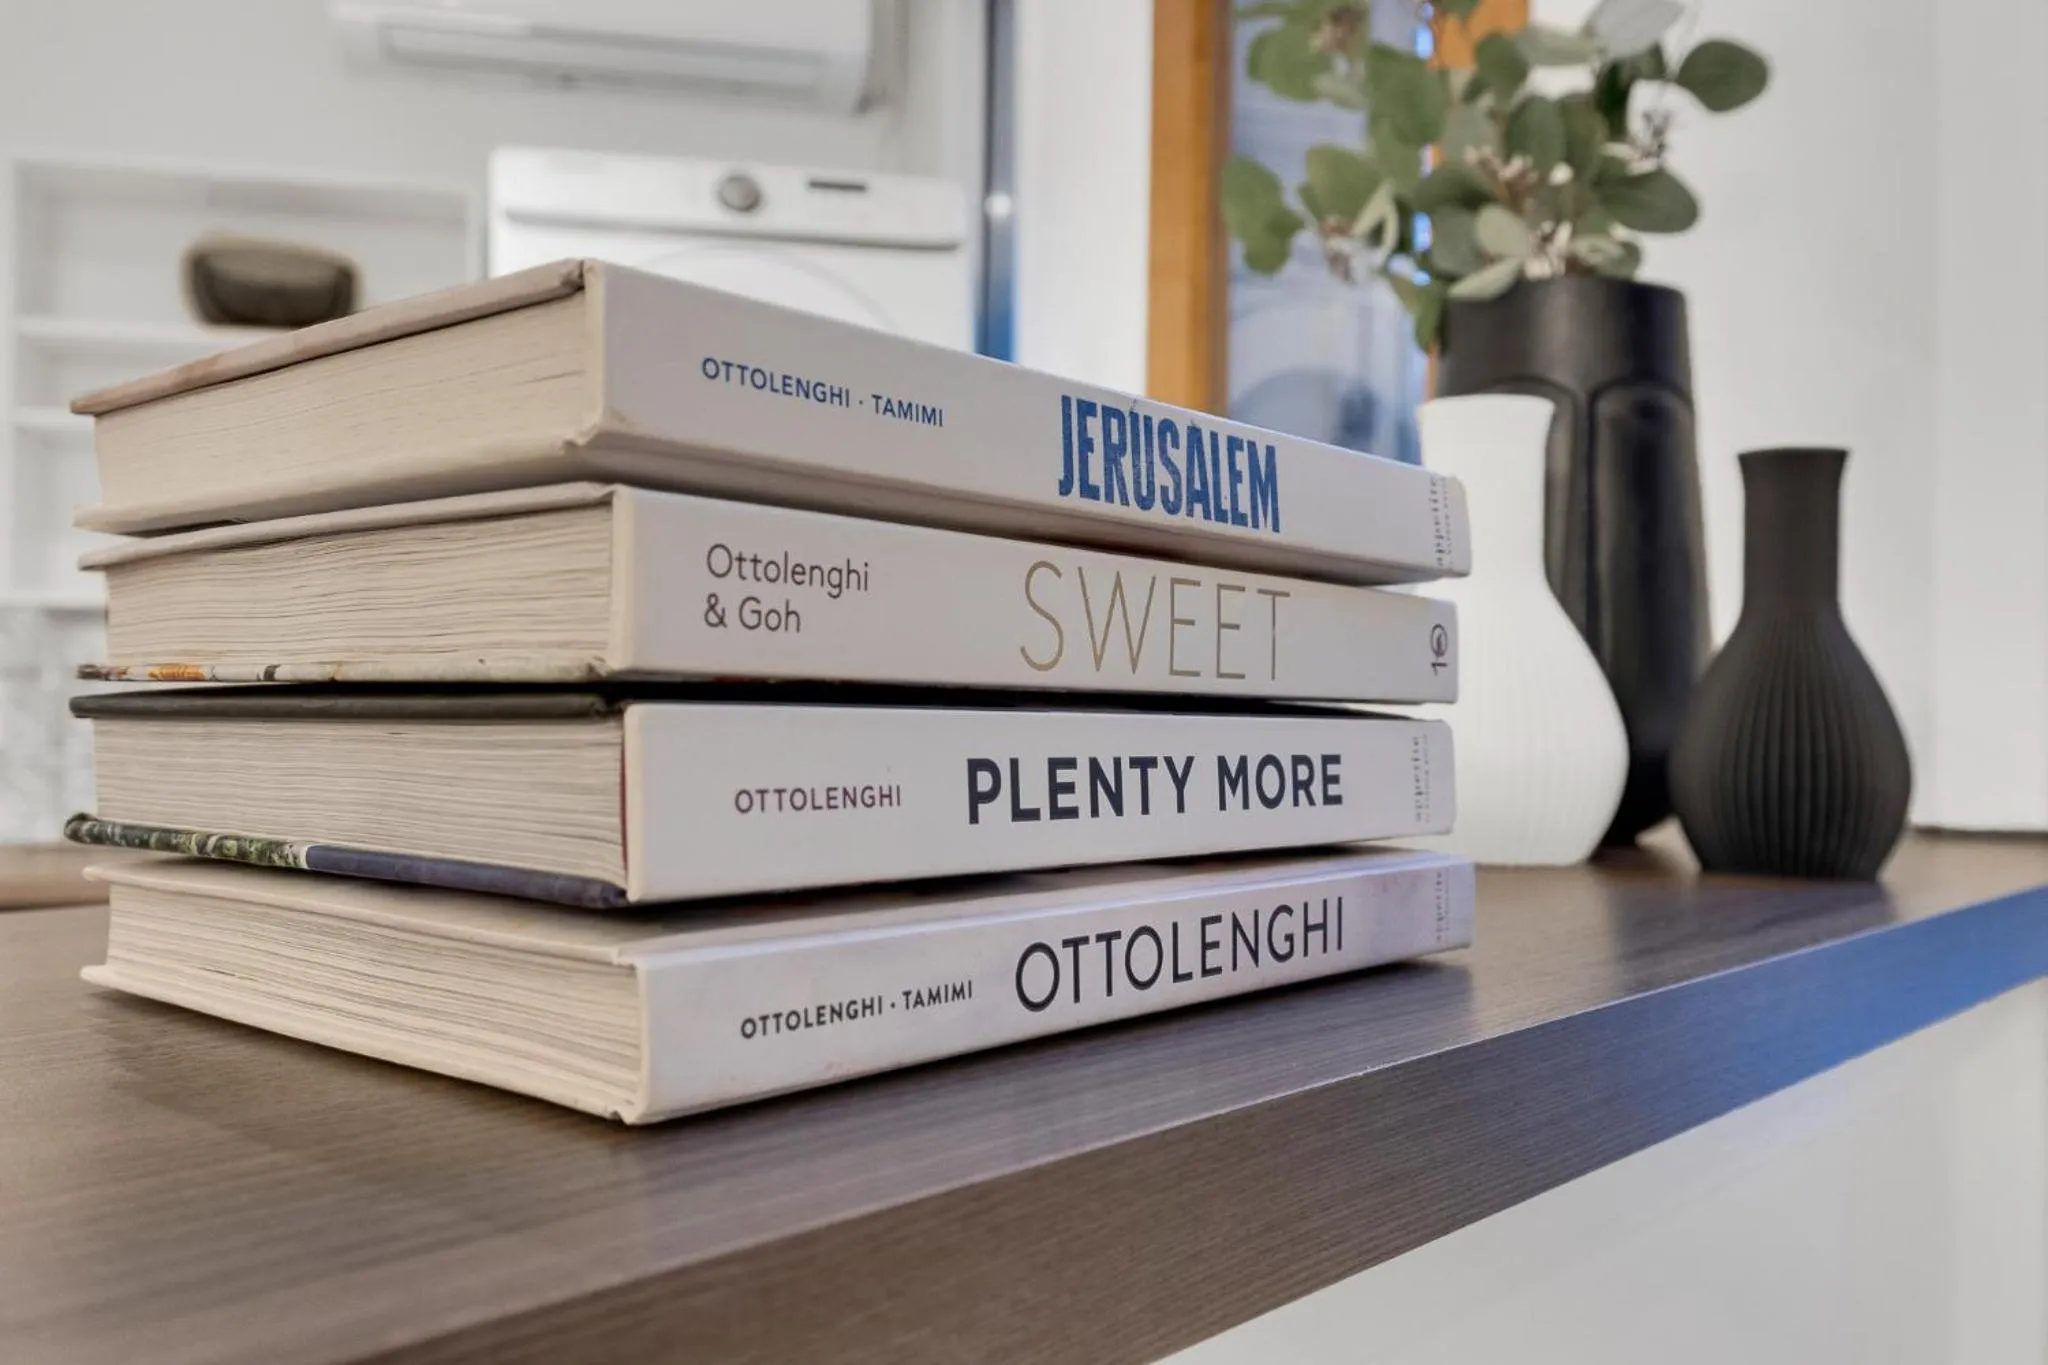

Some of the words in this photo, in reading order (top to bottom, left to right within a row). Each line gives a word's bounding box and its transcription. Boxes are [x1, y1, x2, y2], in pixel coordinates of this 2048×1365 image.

[701, 357, 849, 408] OTTOLENGHI
[872, 394, 943, 427] TAMIMI
[1058, 394, 1281, 534] JERUSALEM
[706, 543, 869, 599] Ottolenghi
[704, 592, 727, 628] &
[739, 597, 801, 633] Goh
[1019, 559, 1291, 681] SWEET
[735, 785, 901, 814] OTTOLENGHI
[966, 756, 1195, 825] PLENTY
[1218, 754, 1343, 812] MORE
[1014, 897, 1344, 1013] OTTOLENGHI
[741, 995, 883, 1040] OTTOLENGHI
[902, 979, 974, 1010] TAMIMI
